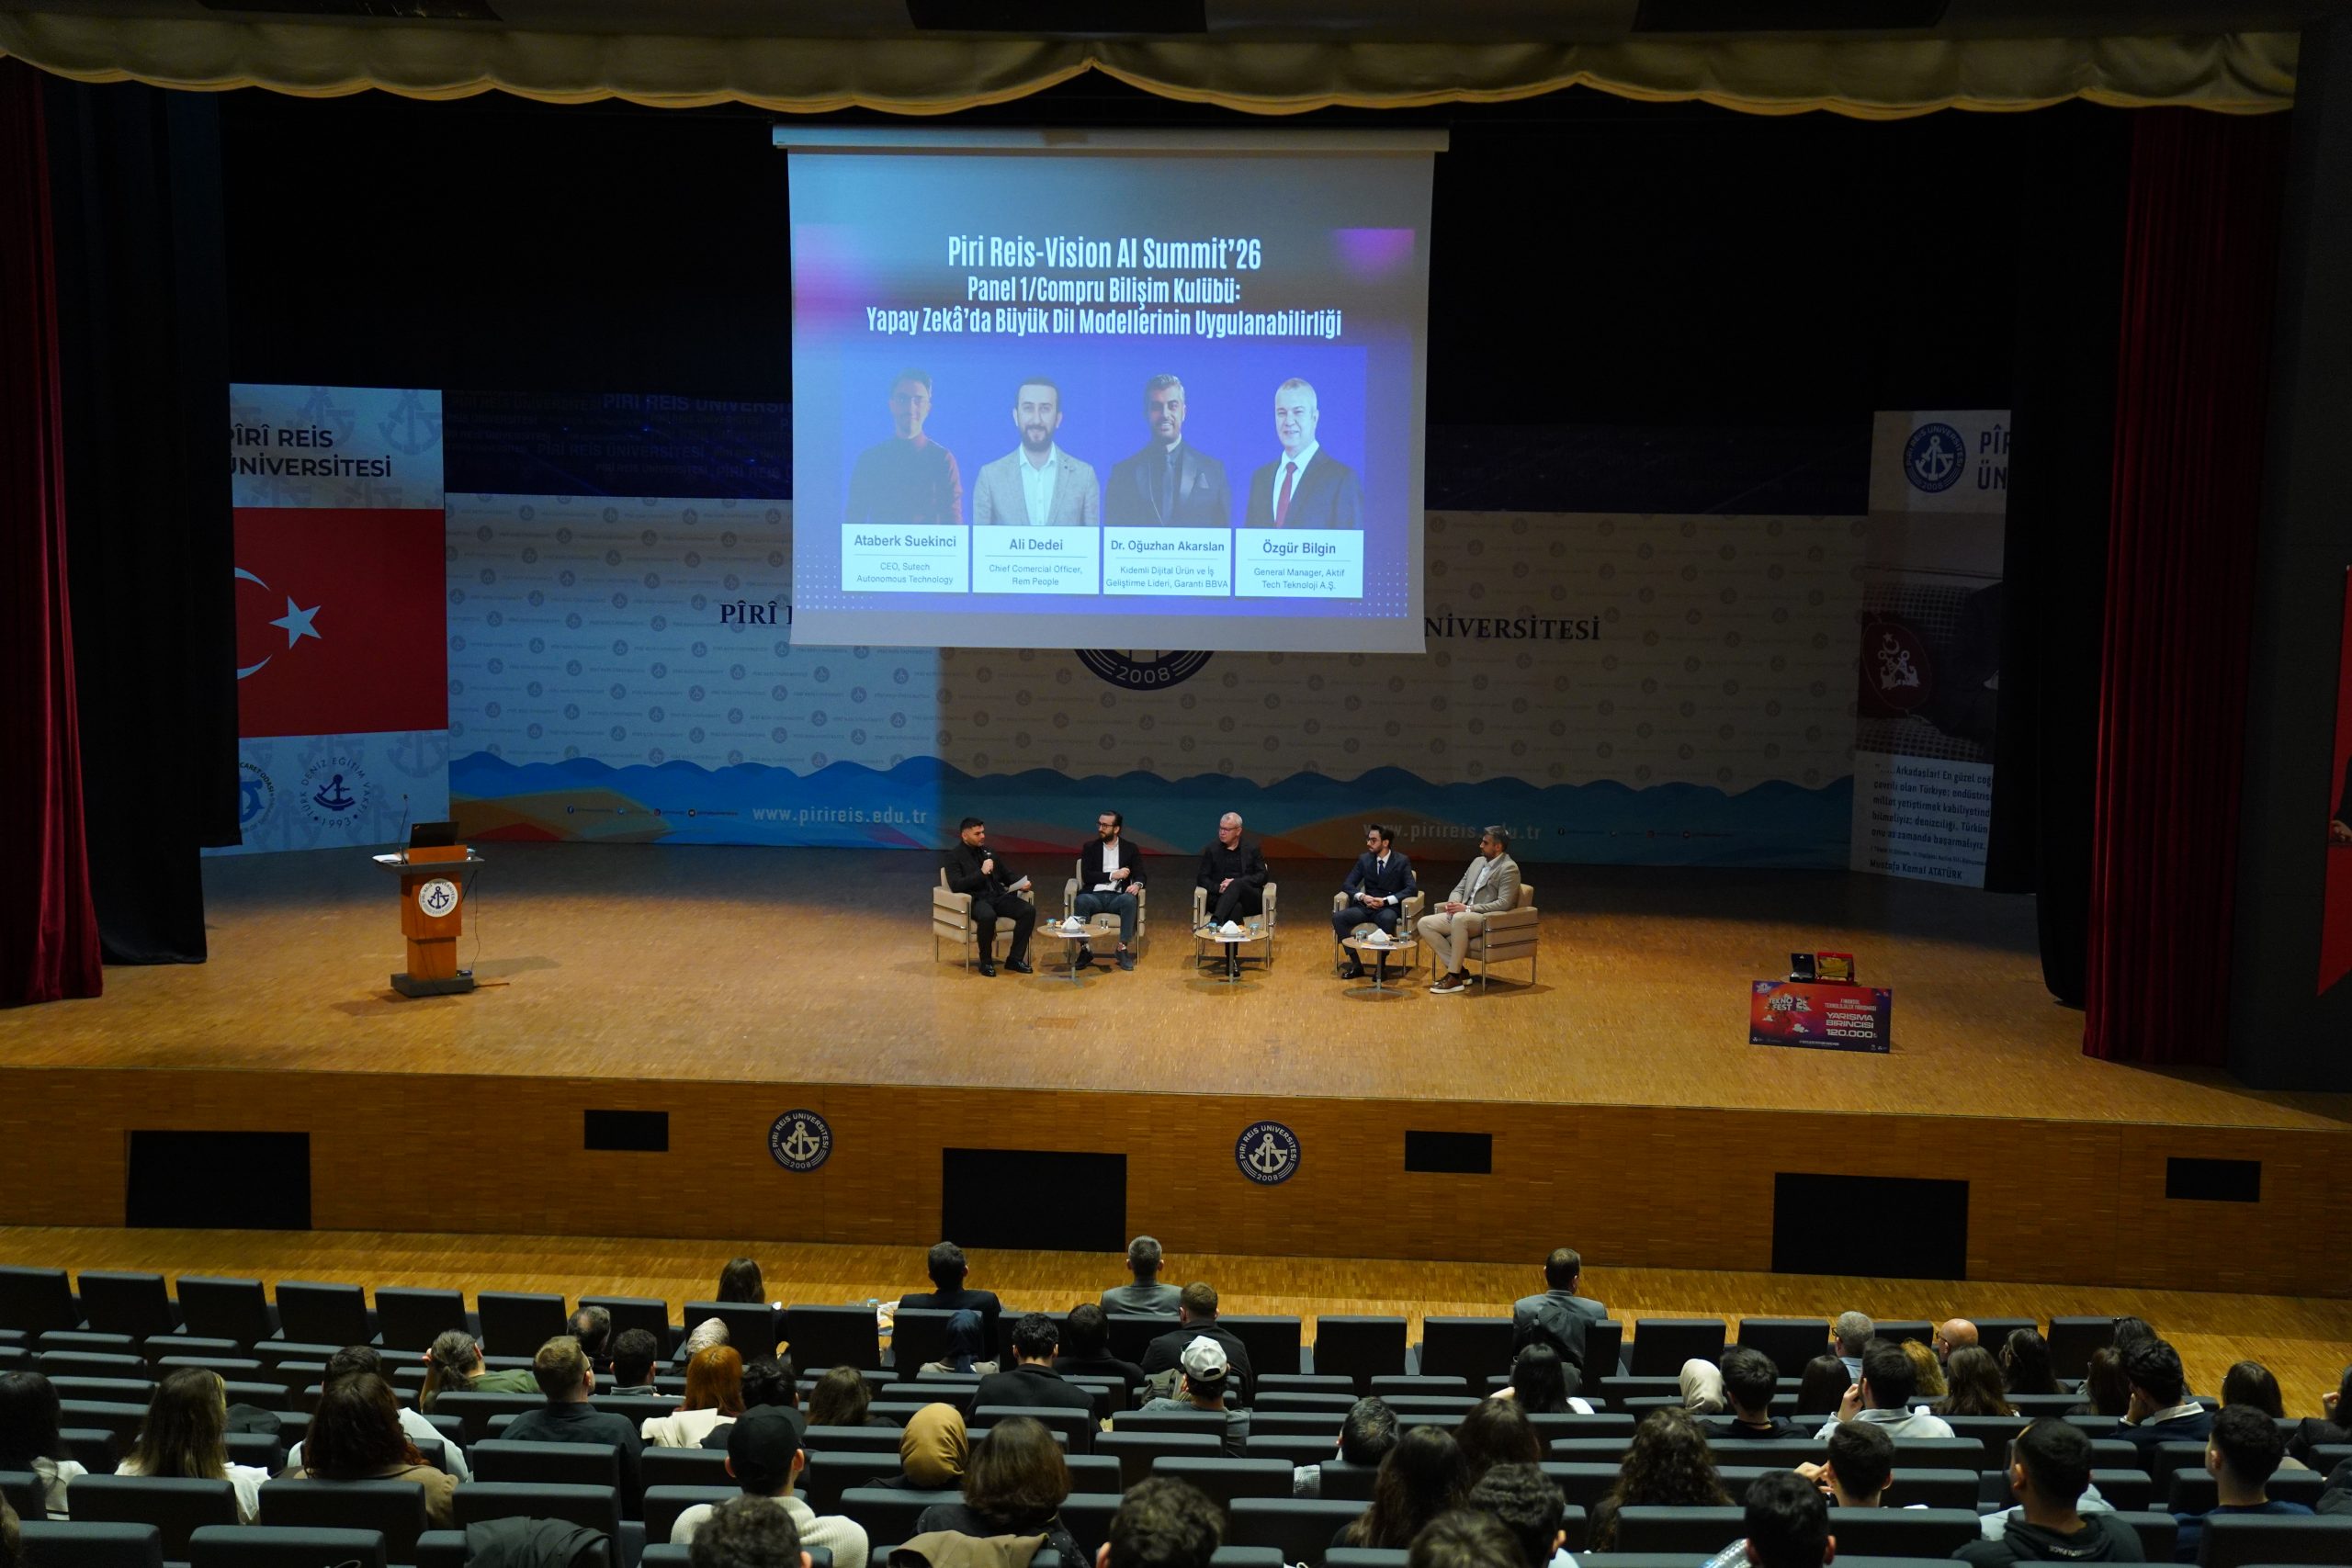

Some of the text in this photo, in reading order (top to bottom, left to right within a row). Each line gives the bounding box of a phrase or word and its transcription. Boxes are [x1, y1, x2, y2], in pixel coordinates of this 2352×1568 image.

[948, 235, 984, 266] Piri
[990, 235, 1111, 268] Reis-Vision
[1117, 237, 1136, 268] AI
[967, 276, 1240, 310] Panel 1/Compru Bilişim Kulübü:
[866, 306, 919, 336] Yapay
[996, 308, 1049, 337] Büyük
[1053, 308, 1074, 333] Dil
[1079, 308, 1191, 335] Modellerinin
[1195, 309, 1341, 340] Uygulanabilirliği
[230, 423, 334, 448] ÎRÎ REİS
[854, 535, 956, 547] Ataberk Suekinci
[1009, 538, 1063, 550] Ali Dedei
[1111, 540, 1225, 553] Dr. Oğuzhan Akarslan
[1262, 538, 1336, 557] Özgür Bilgin
[880, 561, 931, 571] CEO, Sutech
[989, 564, 1083, 575] Chief Comercial Officer,
[1151, 566, 1173, 576] Dijital
[1175, 565, 1194, 575] Ürün
[1253, 568, 1345, 578] General Manager, Aktif
[856, 574, 954, 585] Autonomous Technology
[1012, 577, 1059, 587] Rem People
[1105, 578, 1146, 589] Geliştirme
[1174, 579, 1204, 588] Garanti
[1205, 580, 1228, 588] BBVA
[1261, 580, 1281, 589] Tech
[1283, 581, 1318, 591] Teknoloji
[719, 599, 778, 625] PÎRÎ
[1424, 613, 1600, 641] NİVERSİTESİ
[1116, 665, 1171, 683] 2008
[1954, 772, 1974, 784] güzel
[1977, 775, 1992, 788] coğ
[1952, 788, 1991, 801] endüstris
[752, 806, 927, 826] www.pirireis.edu.tr
[322, 817, 352, 828] 1993
[1928, 865, 1962, 880] ATATÜRK
[790, 1161, 811, 1169] 2008
[1256, 1173, 1279, 1182] 2008
